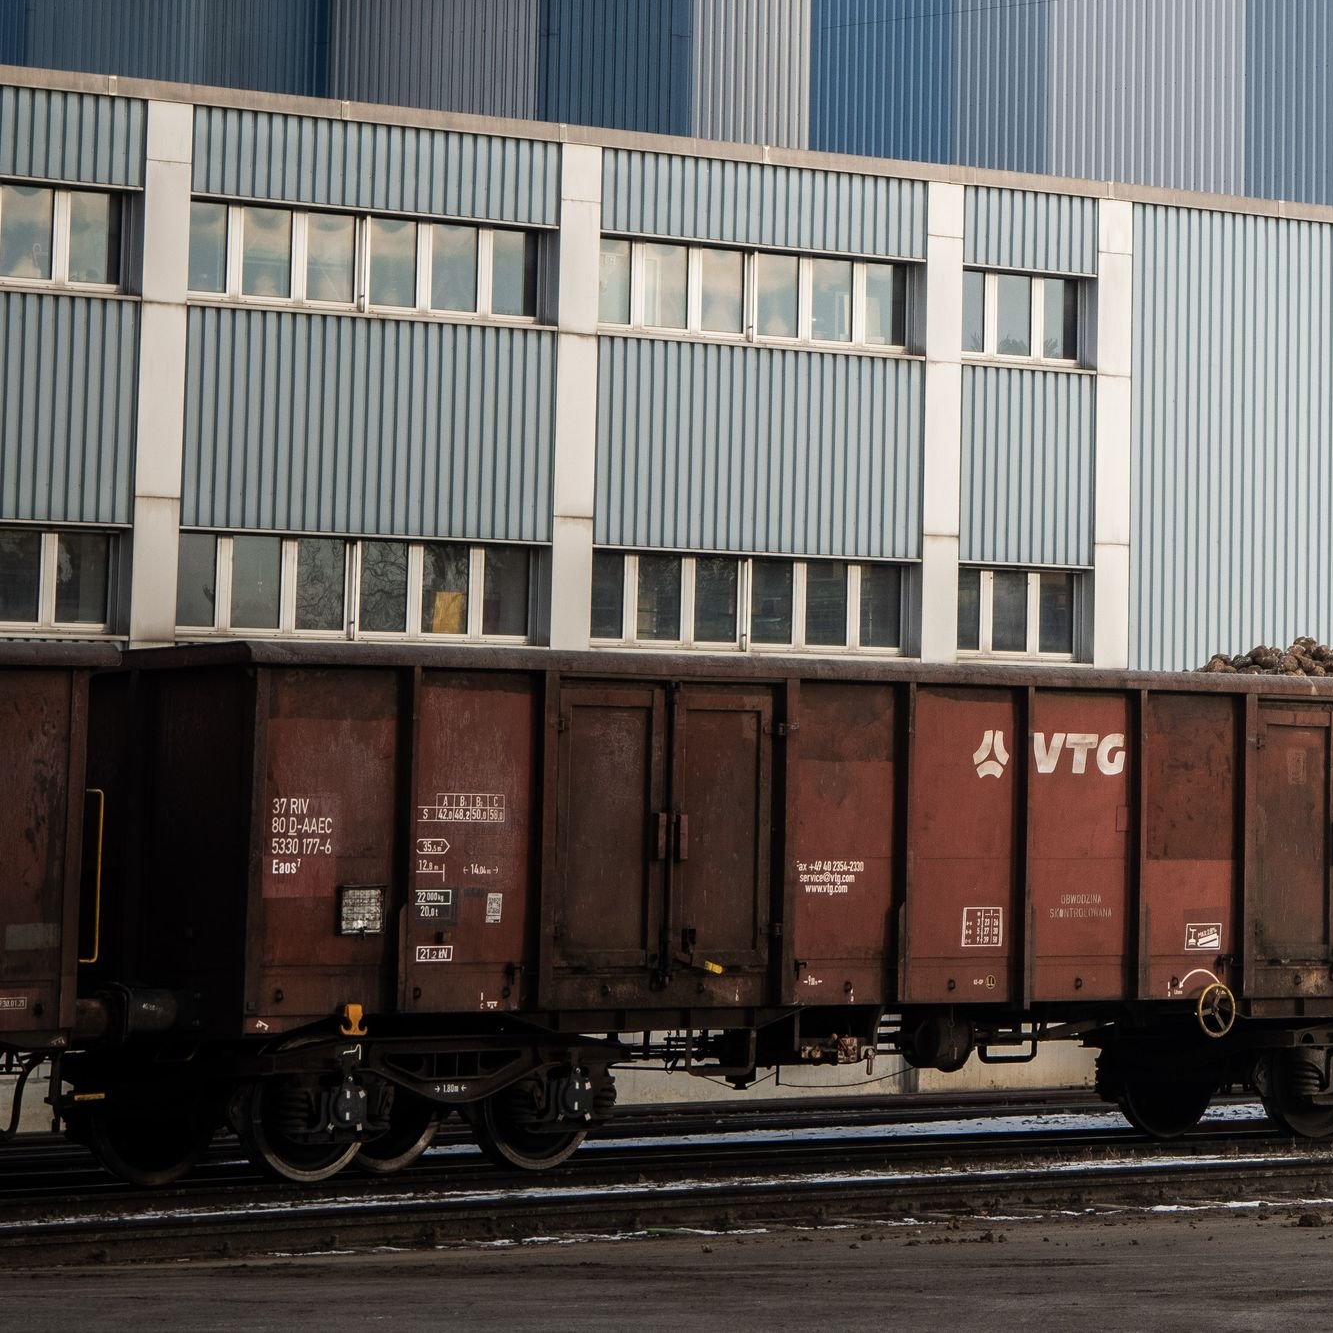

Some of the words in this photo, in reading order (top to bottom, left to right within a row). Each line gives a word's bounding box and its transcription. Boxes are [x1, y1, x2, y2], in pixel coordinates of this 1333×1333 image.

[1033, 732, 1126, 775] VTG
[272, 798, 287, 814] 37
[290, 798, 309, 814] RIV
[442, 795, 449, 807] A
[493, 796, 499, 807] C
[422, 808, 429, 820] S
[271, 817, 286, 834] 80
[288, 817, 333, 835] D-AAEC
[271, 838, 299, 854] 5330
[302, 838, 332, 855] 177-6
[799, 871, 856, 885] service@vtg.com
[805, 883, 848, 896] www.vtg.com
